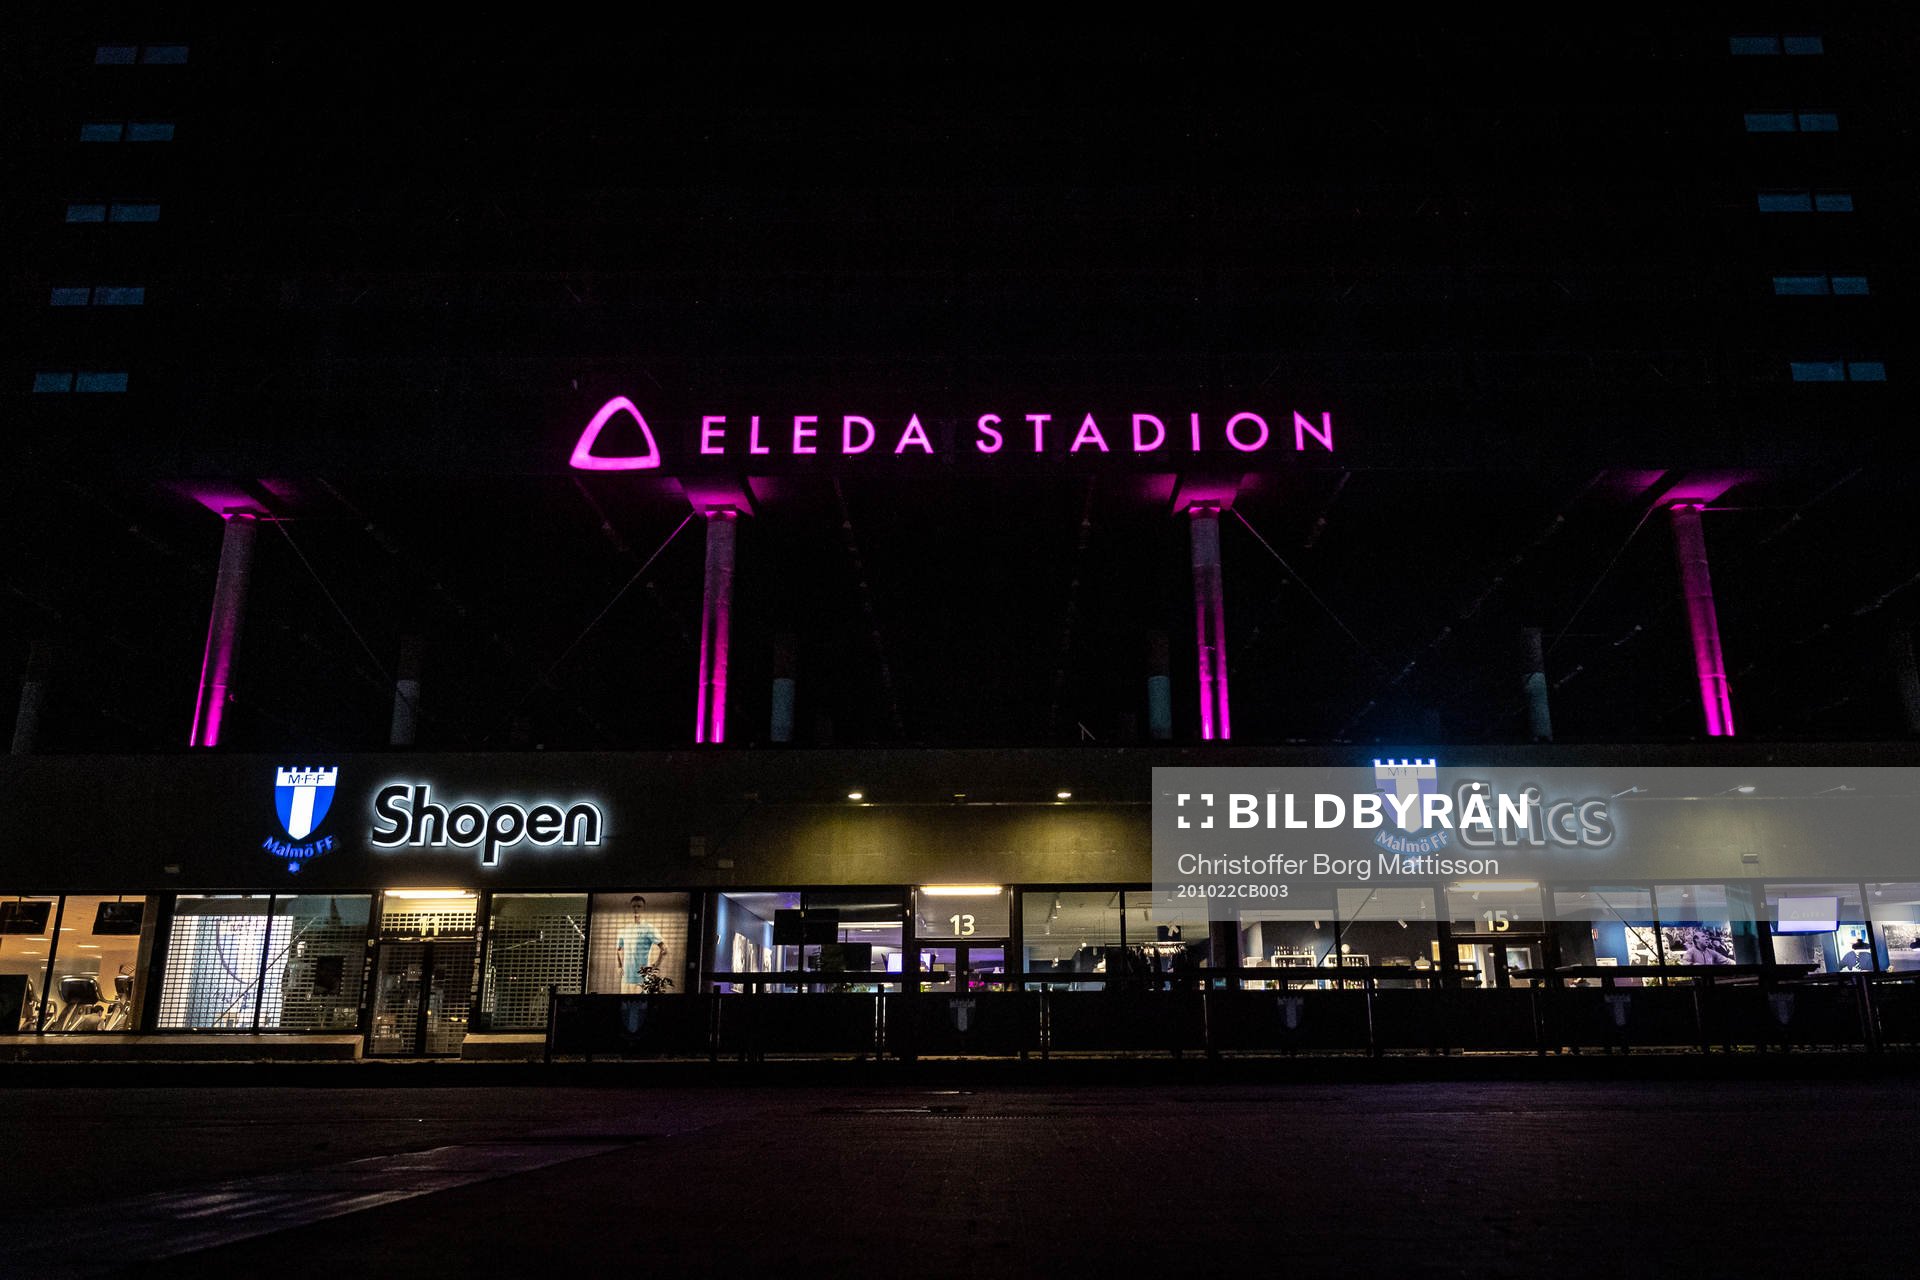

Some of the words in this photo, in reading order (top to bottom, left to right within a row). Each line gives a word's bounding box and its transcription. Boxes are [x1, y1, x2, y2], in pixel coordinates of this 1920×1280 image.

[701, 411, 935, 455] ELEDA
[975, 409, 1334, 455] STADION
[372, 784, 602, 867] Shopen
[263, 836, 315, 858] Malmö
[315, 836, 333, 853] FF
[1376, 831, 1430, 853] Malmö
[1430, 831, 1448, 849] FF
[950, 914, 975, 936] 13
[1483, 910, 1509, 932] 15
